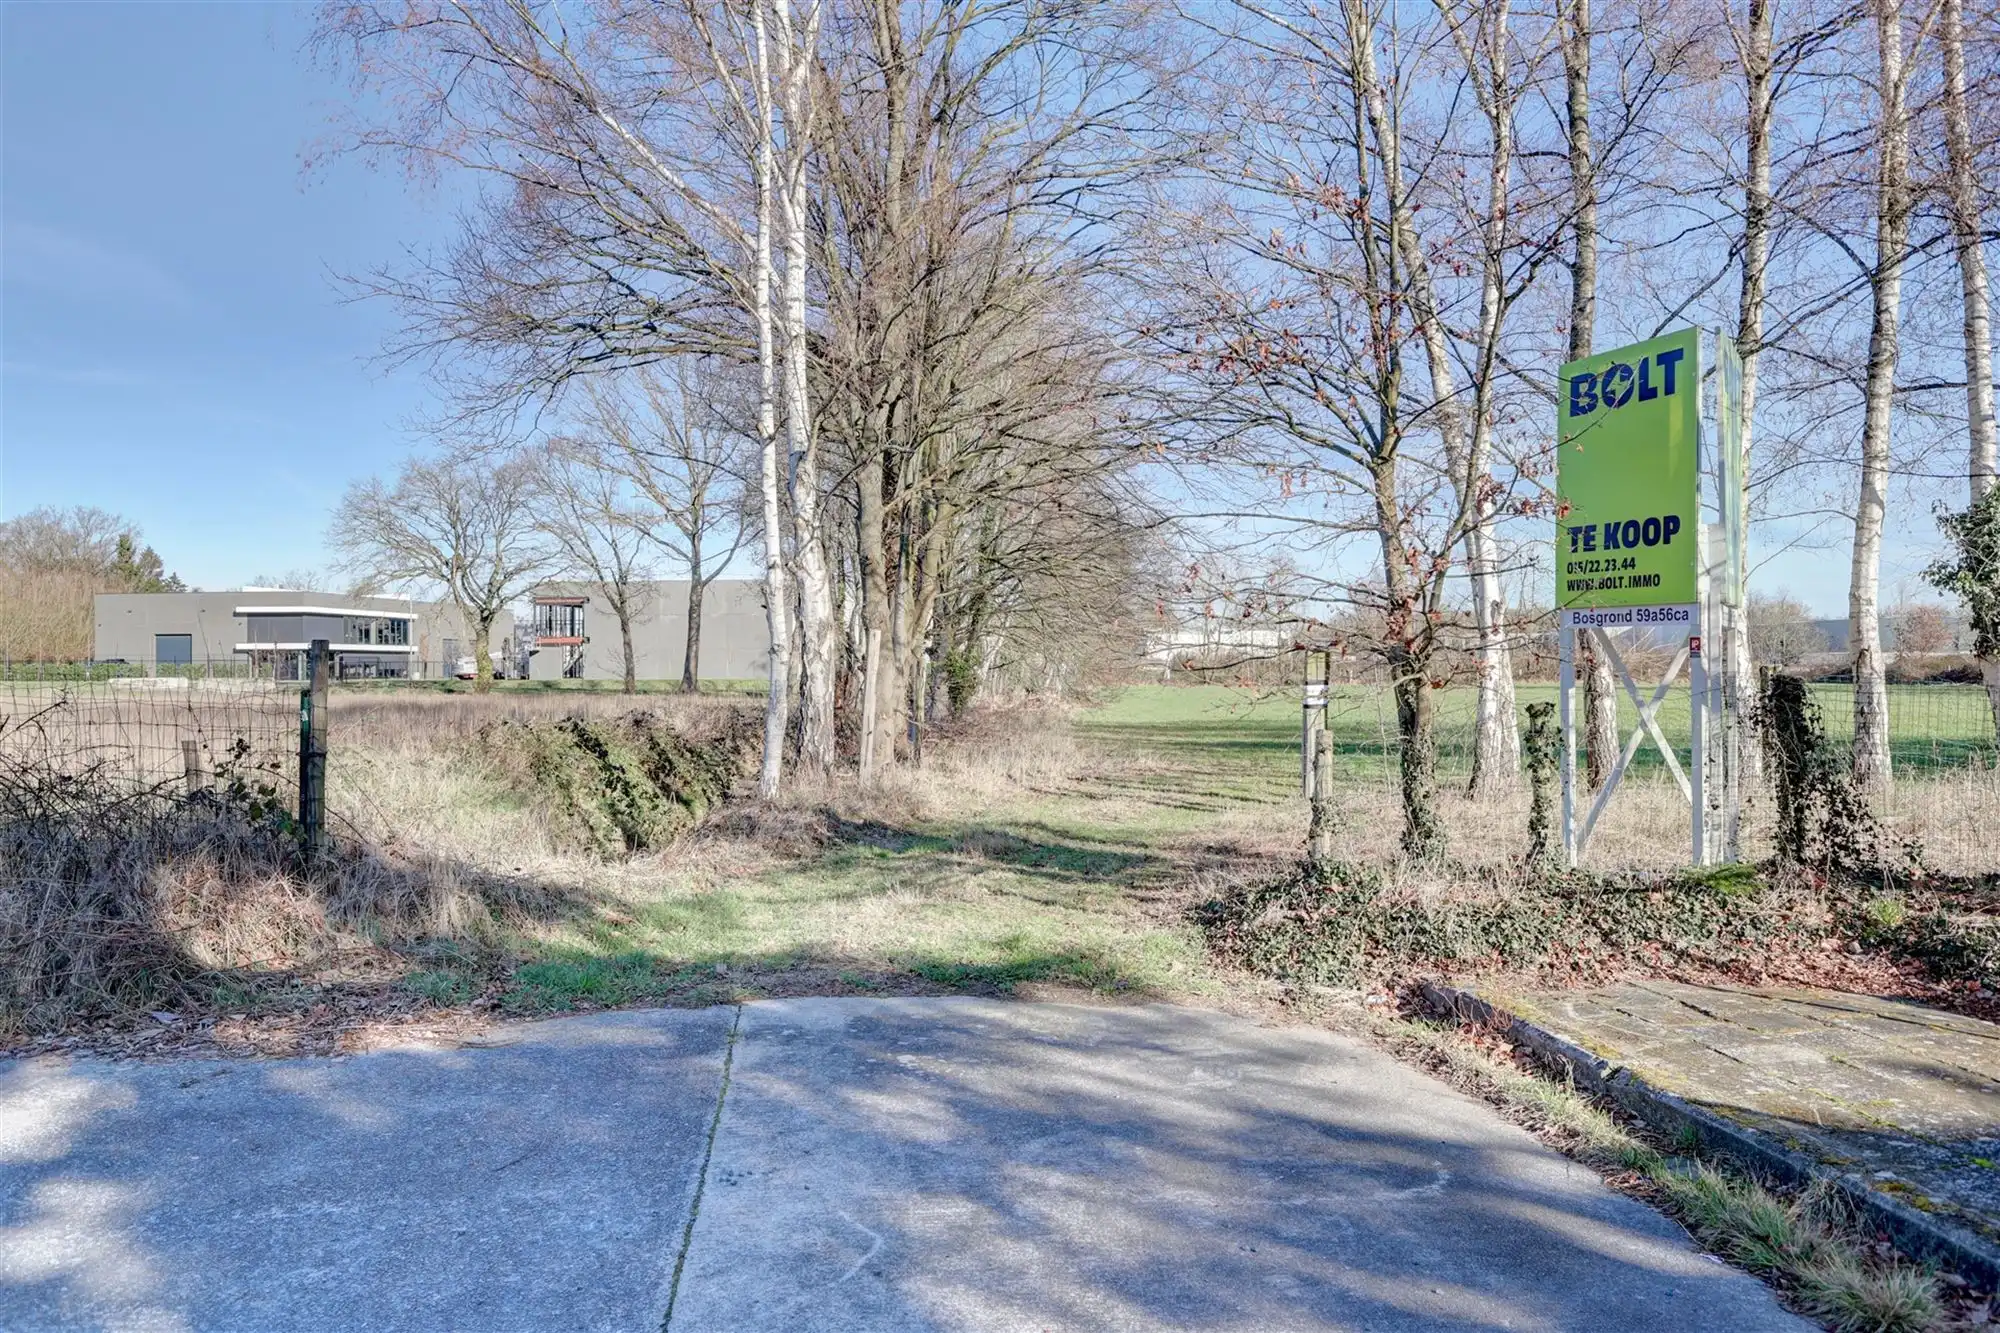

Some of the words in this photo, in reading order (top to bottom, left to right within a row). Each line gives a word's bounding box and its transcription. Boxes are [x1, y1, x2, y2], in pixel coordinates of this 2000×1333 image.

[1569, 348, 1684, 417] BOLT
[1567, 524, 1597, 553] TE
[1603, 515, 1681, 551] KOOP
[1566, 574, 1661, 591] WWW.BOLT.IMMO
[1572, 609, 1633, 627] Bosgrond
[1636, 607, 1689, 622] 59a56ca
